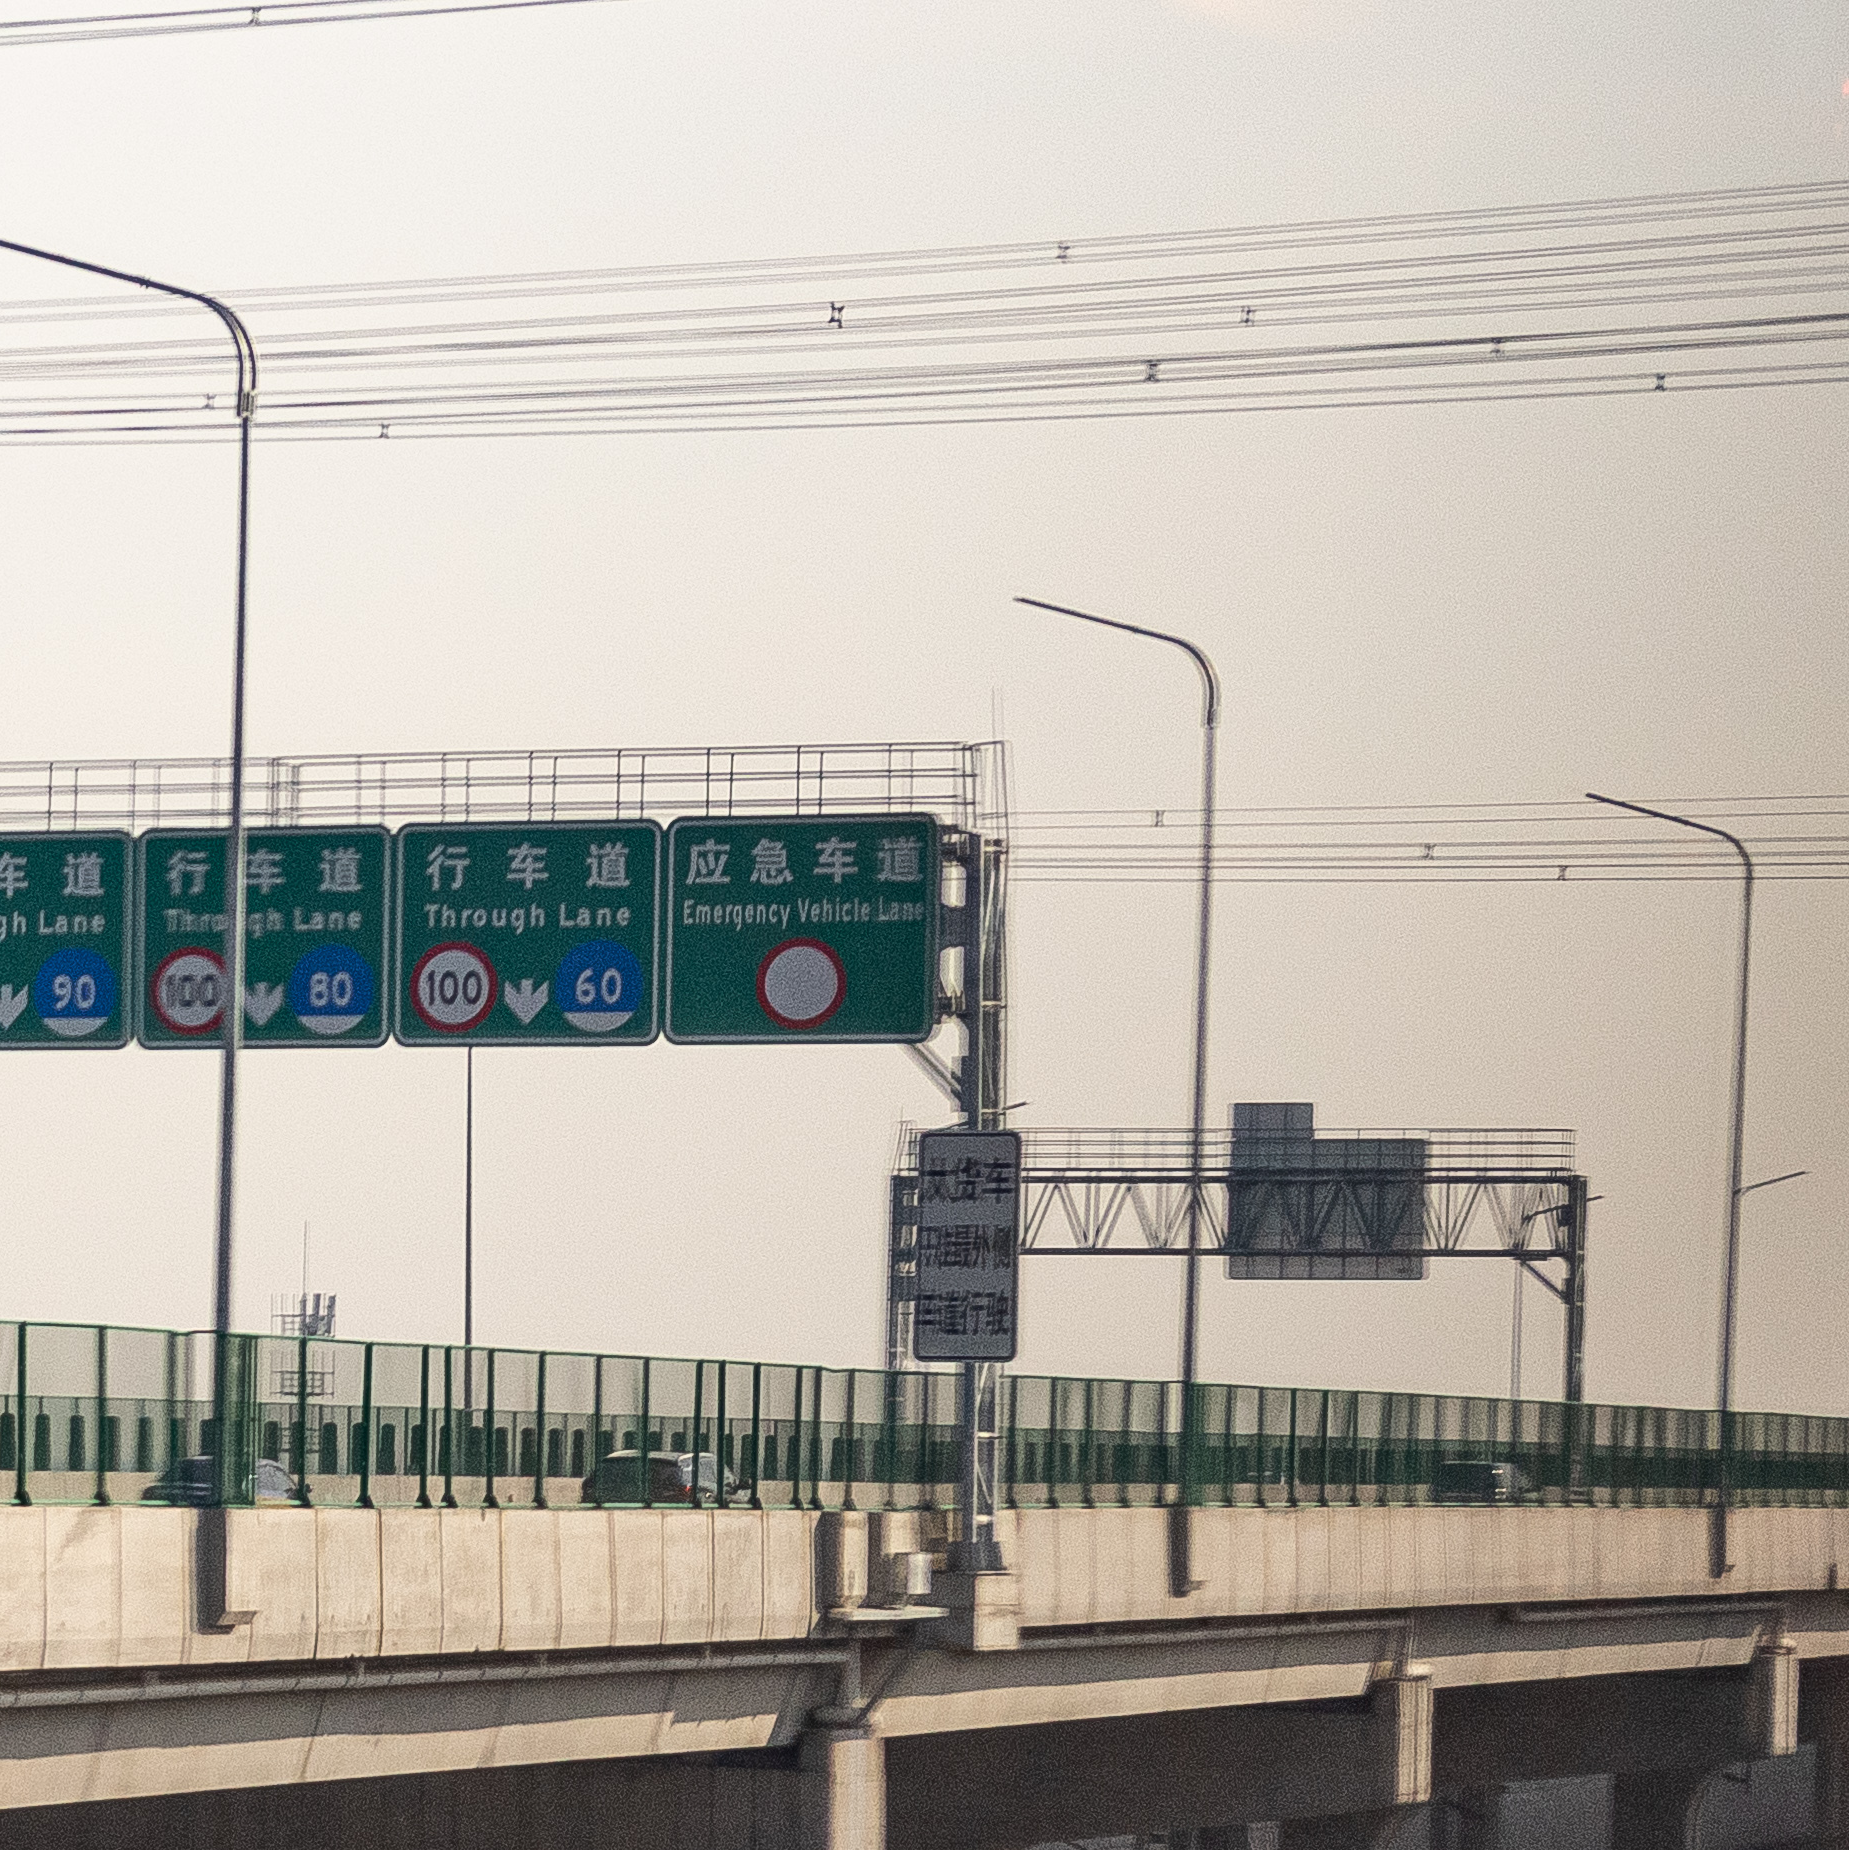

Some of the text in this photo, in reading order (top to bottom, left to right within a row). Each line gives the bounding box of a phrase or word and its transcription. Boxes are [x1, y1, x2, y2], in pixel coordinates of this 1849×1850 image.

[166, 848, 361, 896] 行车道
[426, 842, 631, 890] 行车道
[686, 837, 923, 885] 应急车道
[38, 909, 105, 936] Lane
[164, 907, 362, 938] Throgh Lane
[424, 902, 631, 935] Through Lane
[683, 897, 923, 930] Emergency Vehicle Lane
[53, 974, 97, 1010] 90
[309, 971, 353, 1007] 80
[426, 970, 483, 1006] 100
[575, 967, 622, 1005] 60
